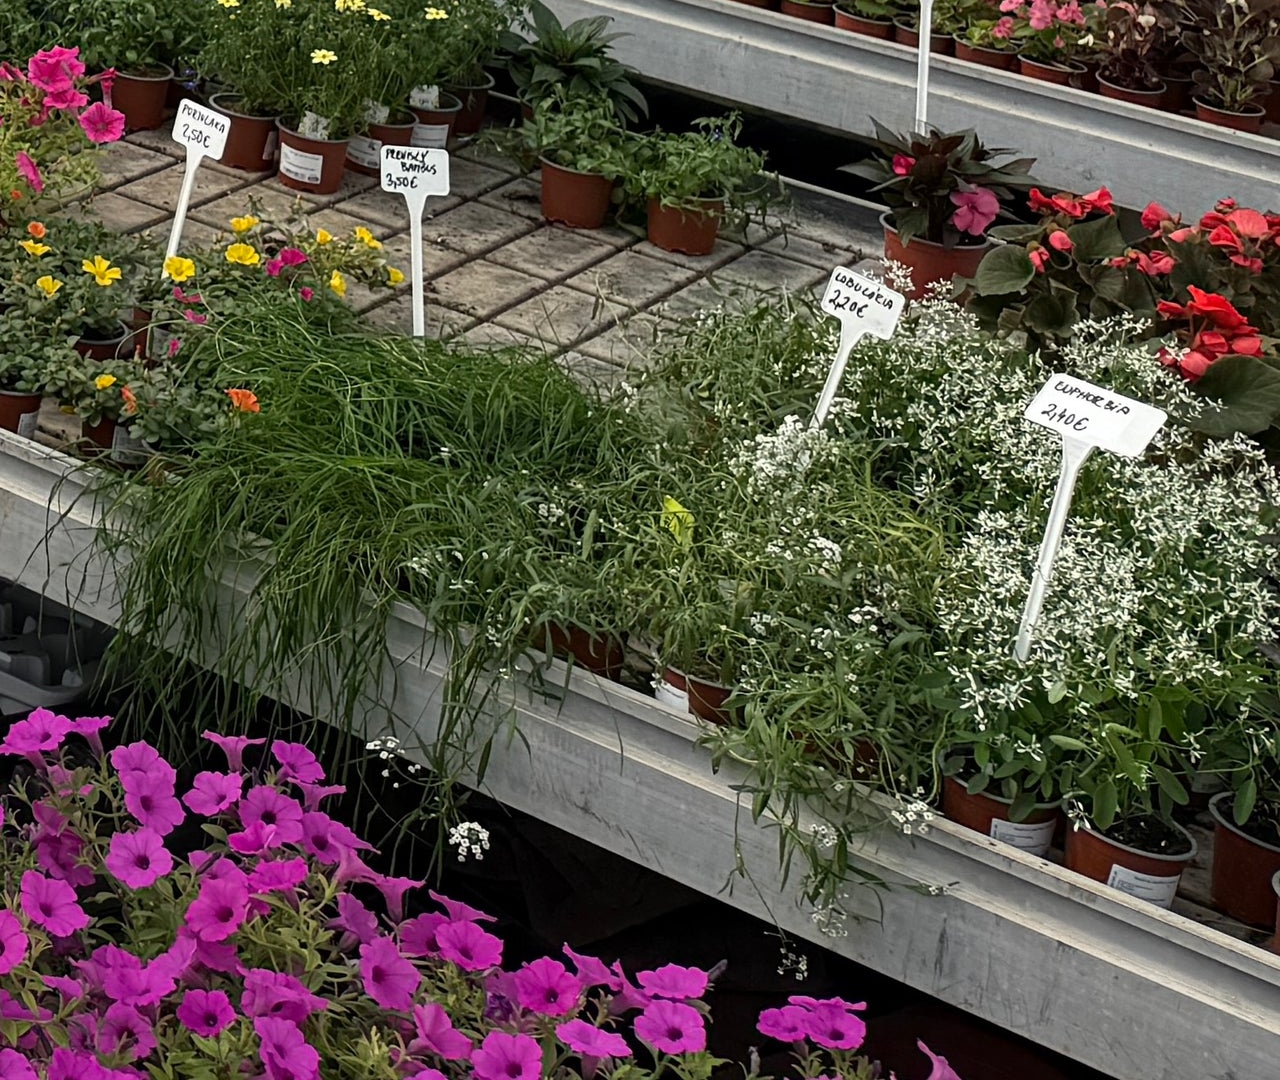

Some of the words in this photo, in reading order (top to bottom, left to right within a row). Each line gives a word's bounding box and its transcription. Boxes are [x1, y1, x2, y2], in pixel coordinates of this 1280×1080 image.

[182, 123, 211, 148] 2,50€
[385, 173, 418, 189] 3,50€
[1041, 403, 1089, 431] 2,40€
